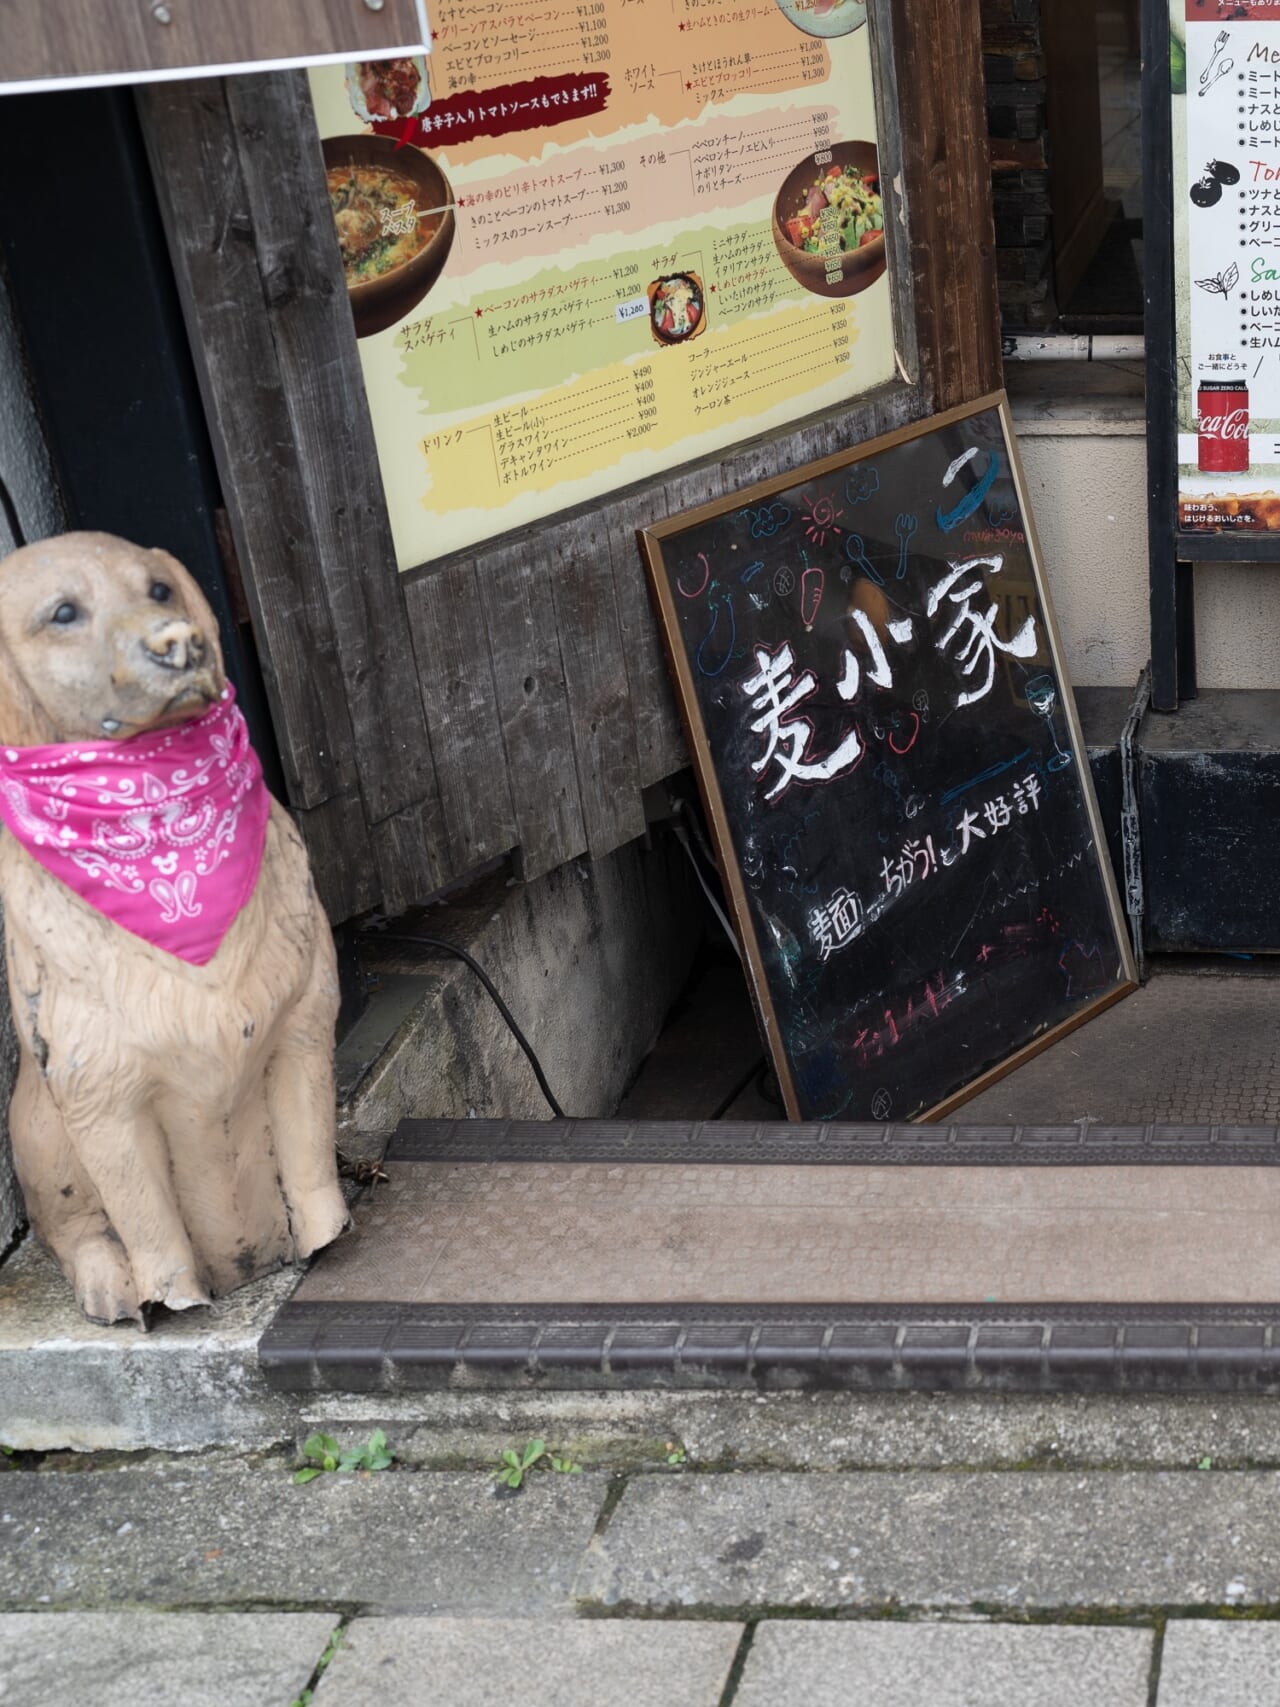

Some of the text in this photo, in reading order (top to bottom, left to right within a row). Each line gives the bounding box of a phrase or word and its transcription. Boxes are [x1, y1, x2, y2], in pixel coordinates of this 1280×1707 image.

[576, 3, 605, 17] ¥1,100
[578, 18, 607, 32] ¥1,100
[581, 34, 609, 48] ¥1,200
[799, 40, 823, 53] ¥1,000
[582, 49, 611, 64] ¥1,300
[801, 54, 824, 67] ¥1,200
[802, 68, 825, 80] ¥1,300
[640, 150, 667, 168] その他
[599, 160, 626, 175] ¥1,300
[601, 180, 628, 196] ¥1,200
[604, 200, 631, 216] ¥1,300
[712, 230, 748, 251] ミニサラダ
[651, 252, 677, 270] サラダ
[613, 264, 639, 279] ¥1,200
[615, 284, 641, 299] ¥1,200
[400, 317, 434, 336] サラダ
[404, 327, 455, 353] スパゲティ
[688, 347, 710, 363] コーラ
[634, 379, 654, 393] ¥400
[493, 366, 652, 427] 生ビール ¥490
[638, 406, 657, 420] ¥900
[499, 393, 656, 455] グラスワイン ¥400
[423, 430, 463, 454] ドリンク
[503, 458, 555, 485] ボトルワイン
[741, 554, 1038, 800] 麦小家
